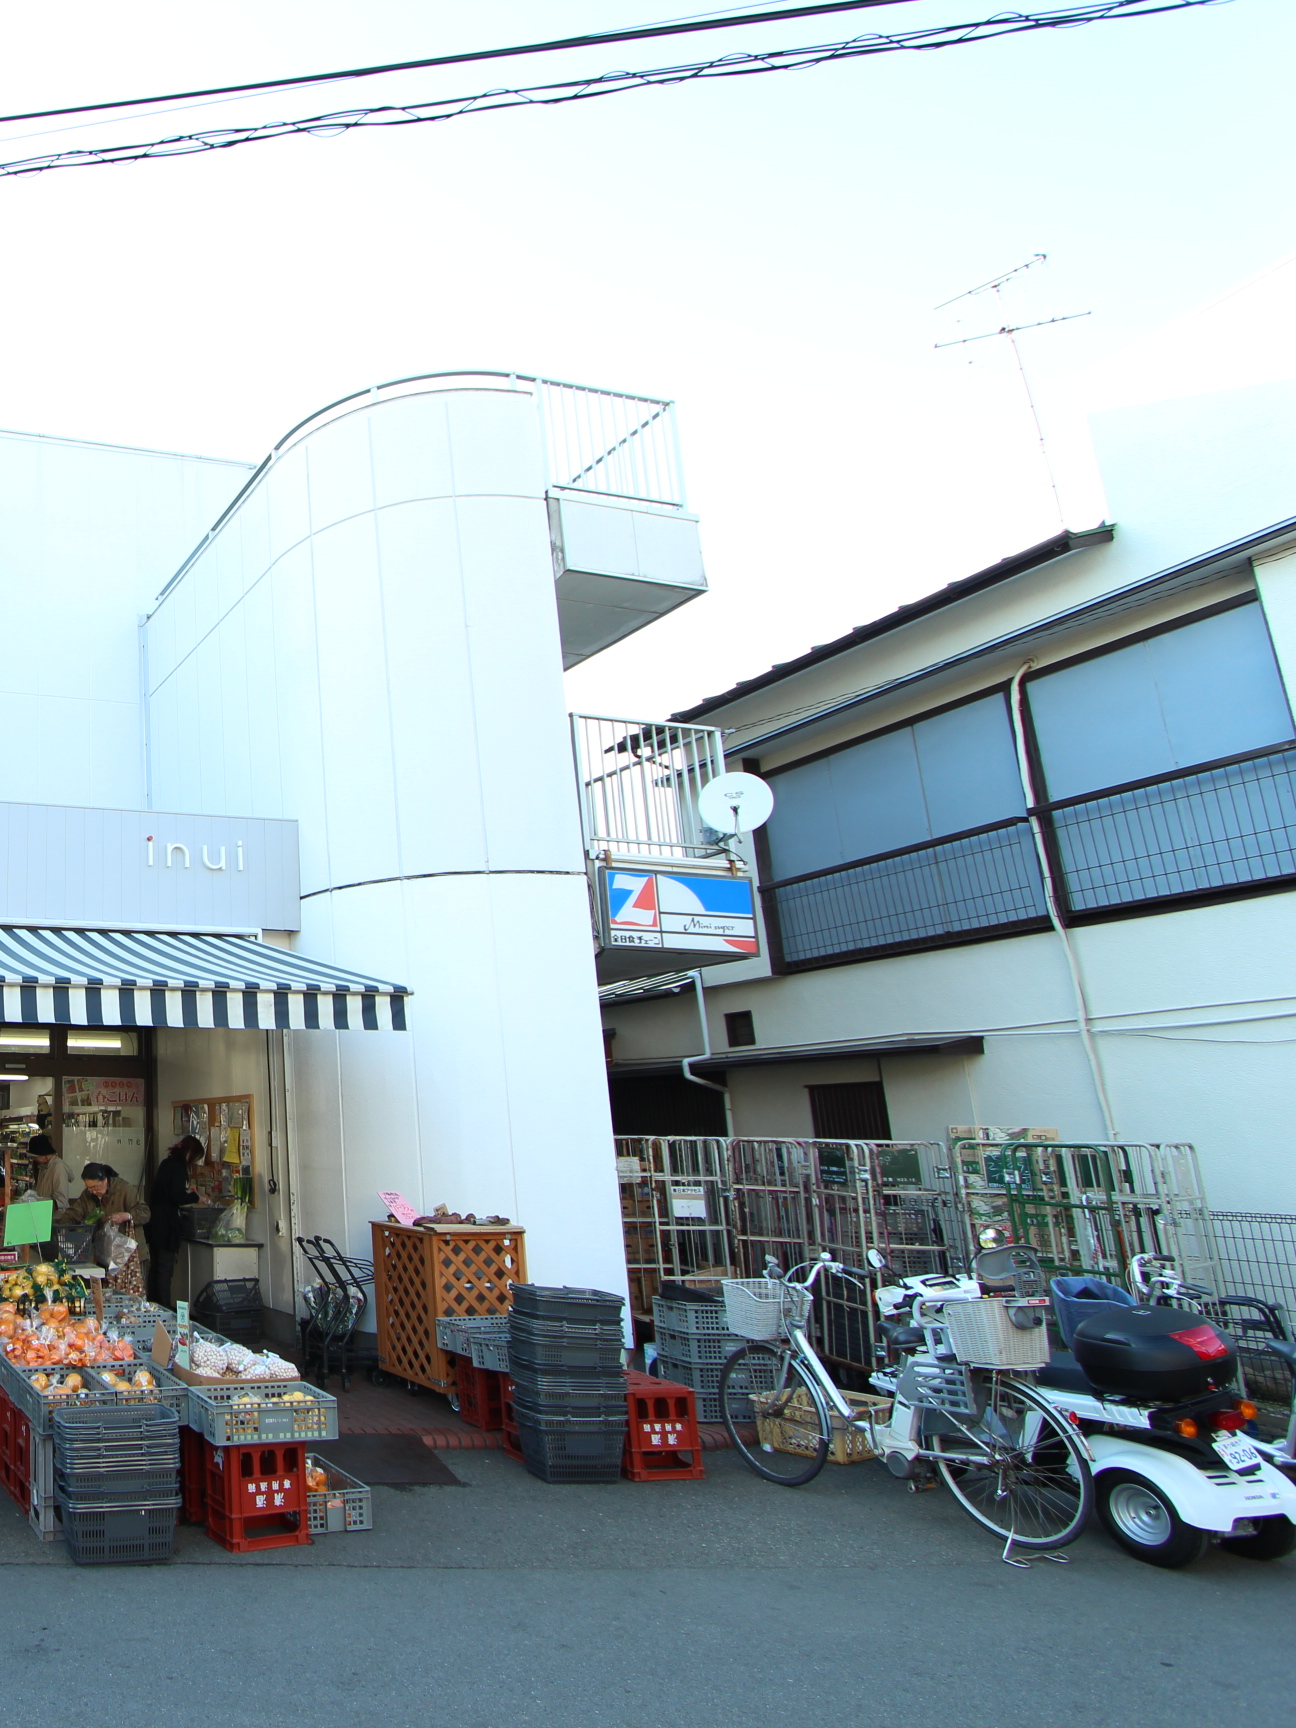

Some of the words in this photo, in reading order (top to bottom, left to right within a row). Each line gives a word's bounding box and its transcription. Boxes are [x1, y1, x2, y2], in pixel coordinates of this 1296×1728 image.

[146, 835, 244, 872] inui
[684, 917, 711, 932] Mini
[713, 924, 736, 935] super
[612, 934, 661, 946] 全日食チェーン
[95, 1090, 141, 1103] 春ごはん
[650, 1433, 678, 1446] 清酒
[1229, 1446, 1258, 1465] 92-06
[247, 1479, 292, 1494] 専用通箱
[255, 1492, 285, 1509] 清酒
